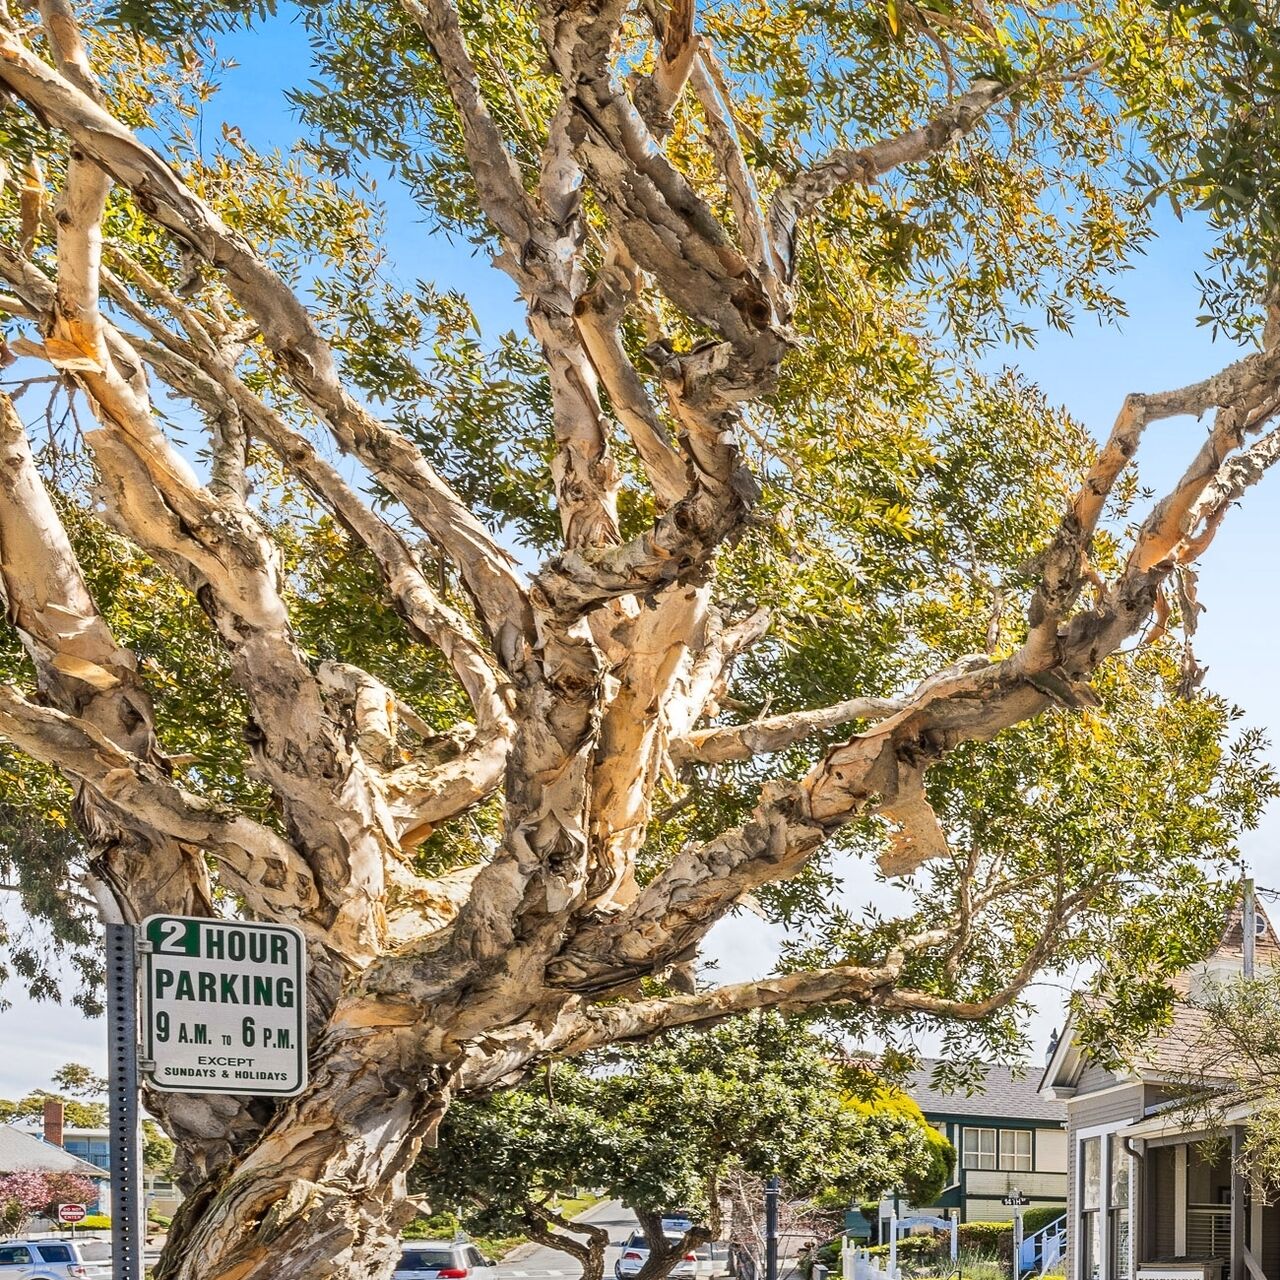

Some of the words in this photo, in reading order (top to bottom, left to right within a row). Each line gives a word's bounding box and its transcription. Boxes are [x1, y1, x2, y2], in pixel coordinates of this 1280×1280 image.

[159, 920, 187, 953] 2
[206, 928, 289, 965] HOUR
[155, 968, 294, 1008] PARKING
[155, 1011, 170, 1043] 9
[178, 1023, 212, 1045] A.M.
[221, 1034, 232, 1046] TO
[241, 1016, 256, 1048] 6
[263, 1028, 295, 1050] P.M.
[164, 1067, 217, 1079] SUNDAYS
[221, 1069, 230, 1079] &
[234, 1070, 288, 1081] HOLIDAYS
[198, 1056, 255, 1067] EXCEPT
